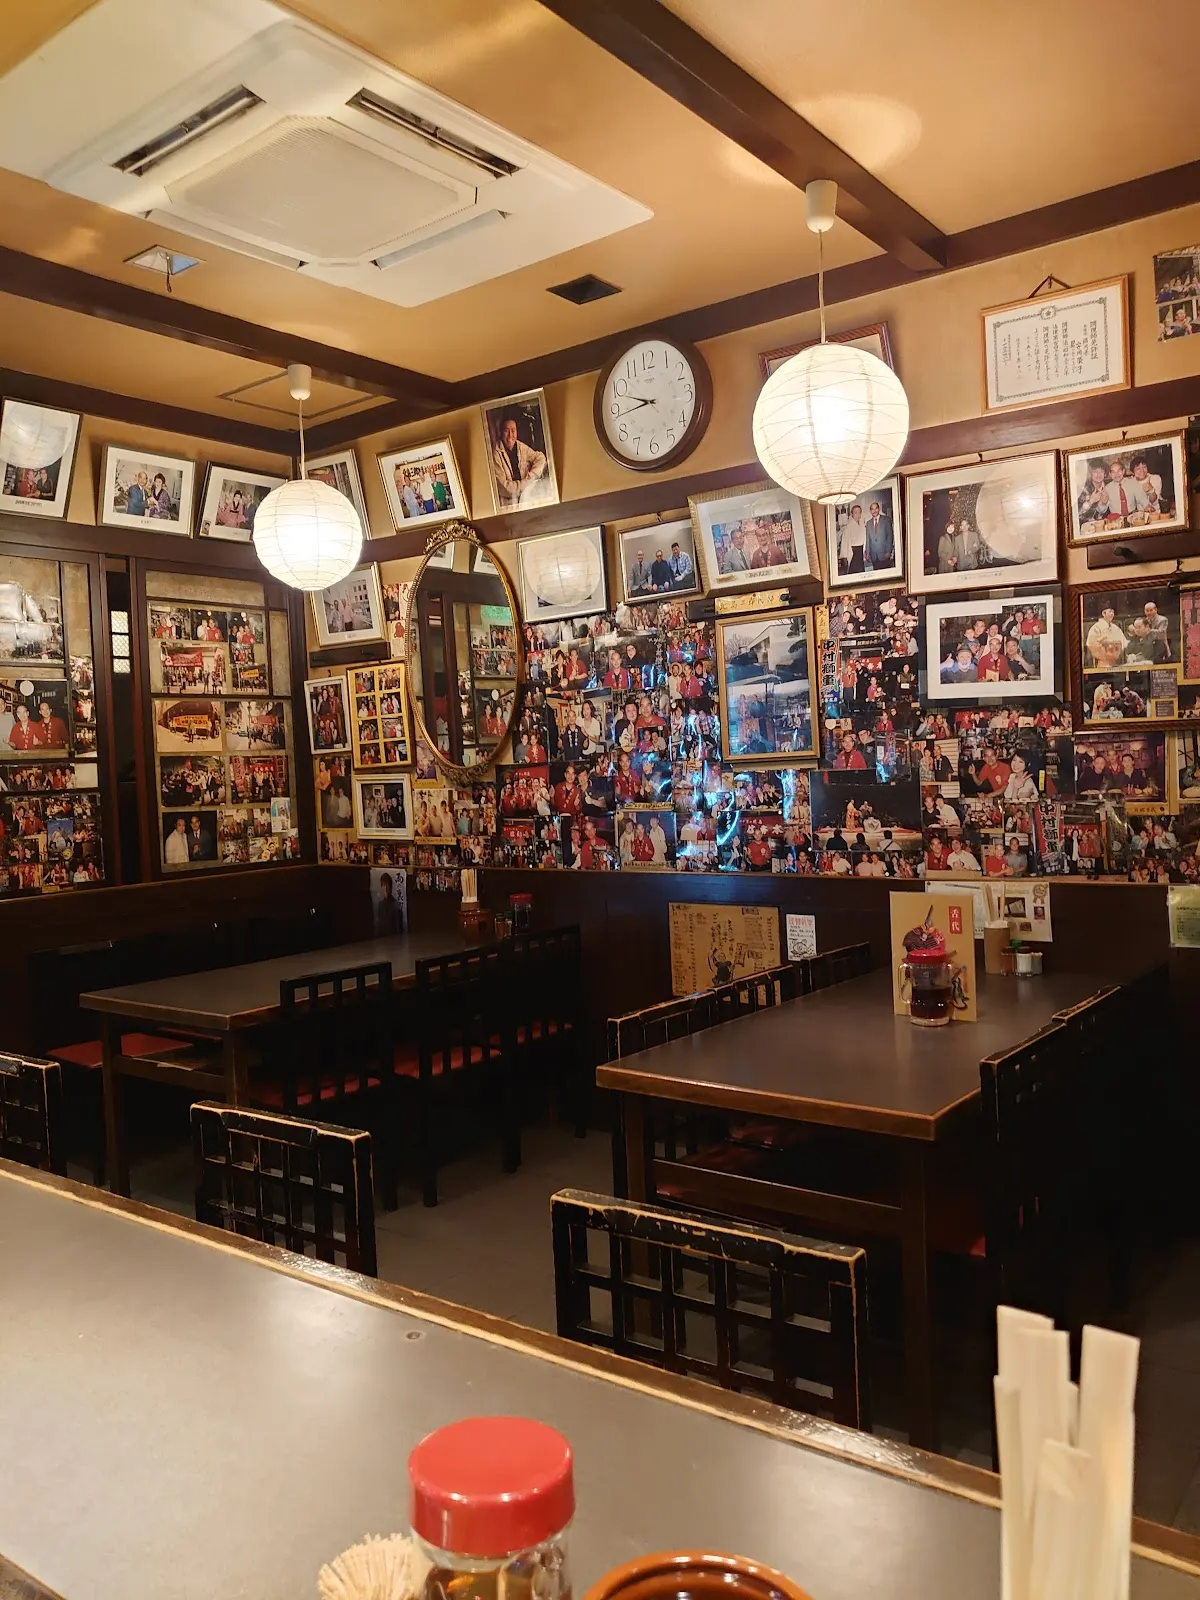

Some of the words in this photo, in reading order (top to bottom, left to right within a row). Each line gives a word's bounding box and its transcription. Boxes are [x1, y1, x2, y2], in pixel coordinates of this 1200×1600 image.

[626, 359, 637, 379] 11
[641, 350, 655, 370] 12
[664, 350, 669, 369] 1
[675, 361, 685, 381] 2
[612, 378, 628, 398] 10
[683, 383, 693, 403] 3
[610, 402, 620, 421] 9
[678, 409, 686, 427] 4
[618, 423, 629, 442] 8
[666, 428, 676, 449] 5
[632, 436, 641, 455] 7
[649, 435, 660, 454] 6
